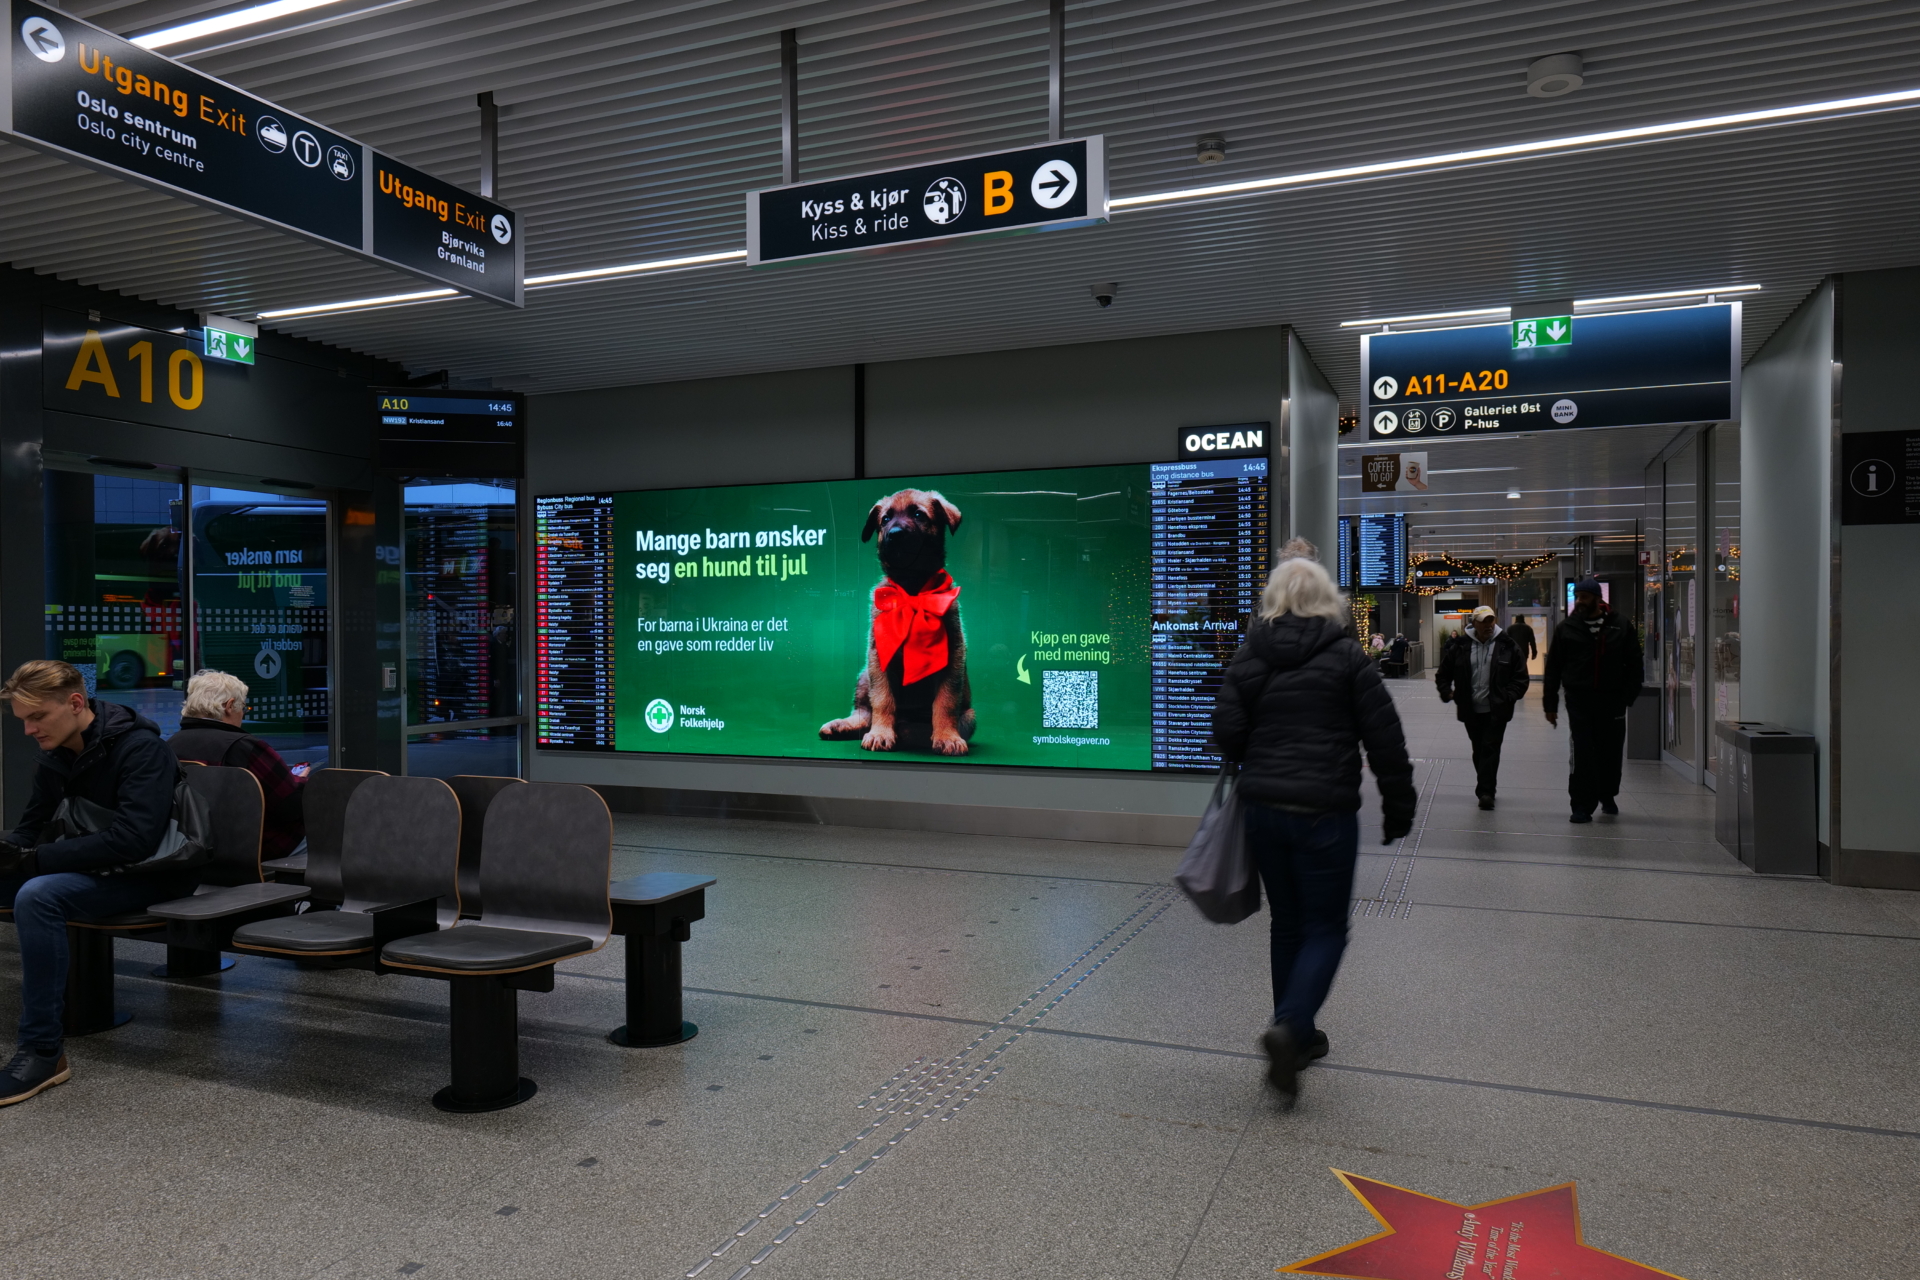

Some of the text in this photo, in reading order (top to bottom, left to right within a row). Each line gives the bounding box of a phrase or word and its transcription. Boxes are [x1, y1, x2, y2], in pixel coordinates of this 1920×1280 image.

[79, 43, 247, 136] Utgang Exit
[78, 91, 197, 149] Oslo sentrum
[78, 114, 204, 172] Oslo city centre
[333, 150, 348, 161] TAXI
[380, 170, 486, 232] Utgang Exit
[983, 171, 1013, 216] B
[801, 187, 909, 221] Kyss & kjør
[812, 213, 909, 242] Kiss & ride
[442, 231, 485, 258] Bjørvika
[438, 247, 485, 273] Grønland
[65, 328, 204, 411] A10
[1405, 369, 1509, 396] A11-A20
[382, 399, 512, 412] A10 14:45
[1465, 405, 1517, 416] Galleriet
[1521, 402, 1540, 414] Øst
[1465, 420, 1499, 429] P-hus
[1186, 430, 1263, 452] OCEAN
[1243, 463, 1265, 471] 14:45
[1368, 461, 1394, 472] COFFEE
[1370, 472, 1392, 482] TO GO!
[636, 525, 827, 555] Mange barn ønsker
[636, 554, 807, 583] seg en hund til jul
[638, 617, 788, 632] For barna i Ukraina er det
[1153, 620, 1238, 630] Ankomst Arrival
[638, 636, 774, 655] en gave som redder liv
[1031, 631, 1110, 647] Kjøp en gave
[1035, 648, 1110, 664] med mening
[680, 705, 705, 715] Norsk
[680, 718, 724, 730] Folkehjelp
[1033, 735, 1110, 747] symbolskegaver.no
[1489, 1226, 1504, 1241] Time
[1510, 1232, 1522, 1242] the
[1446, 1213, 1481, 1280] Andy Williams
[1485, 1249, 1498, 1259] the
[1488, 1242, 1500, 1250] of
[1506, 1242, 1520, 1259] Most
